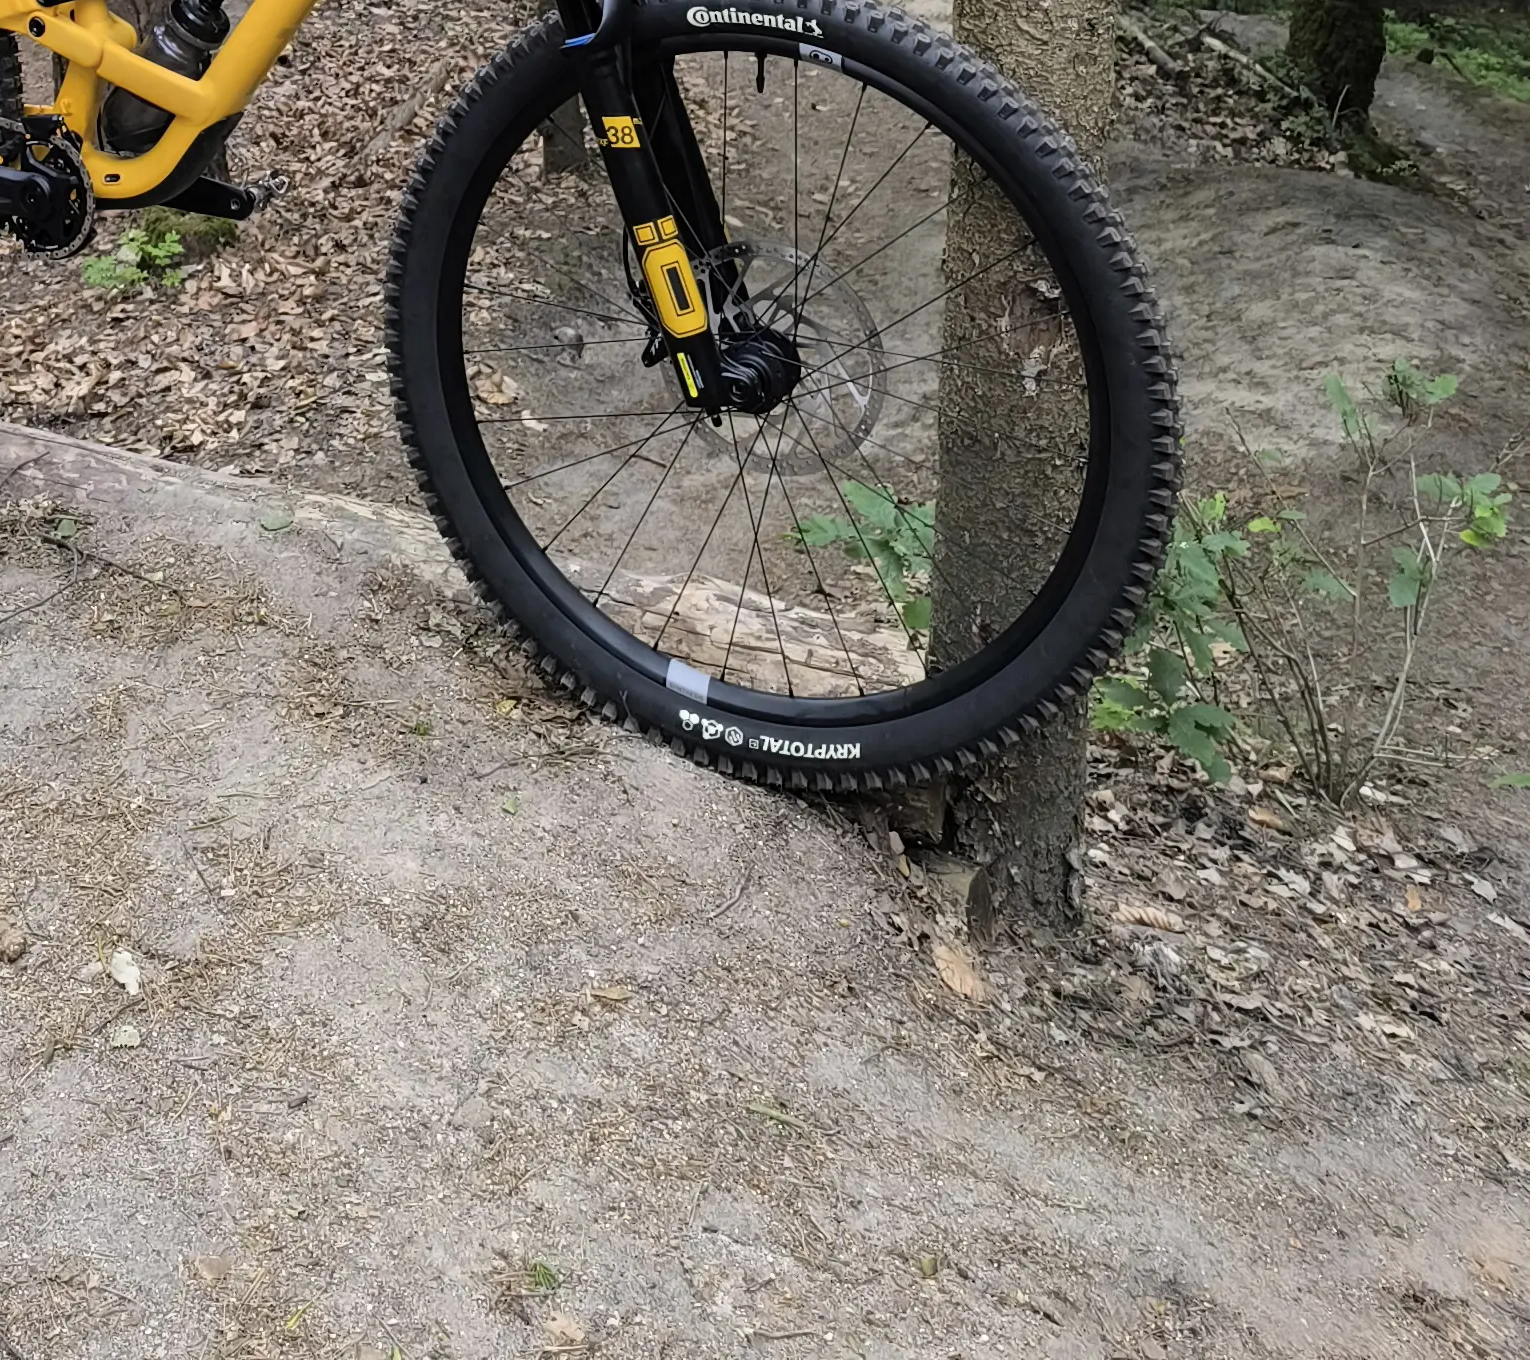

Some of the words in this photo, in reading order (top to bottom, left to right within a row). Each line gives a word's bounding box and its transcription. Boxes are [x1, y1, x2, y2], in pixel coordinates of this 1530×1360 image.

[686, 6, 804, 33] Continental
[606, 125, 634, 145] 38
[759, 735, 861, 760] KRYPTOTAL
